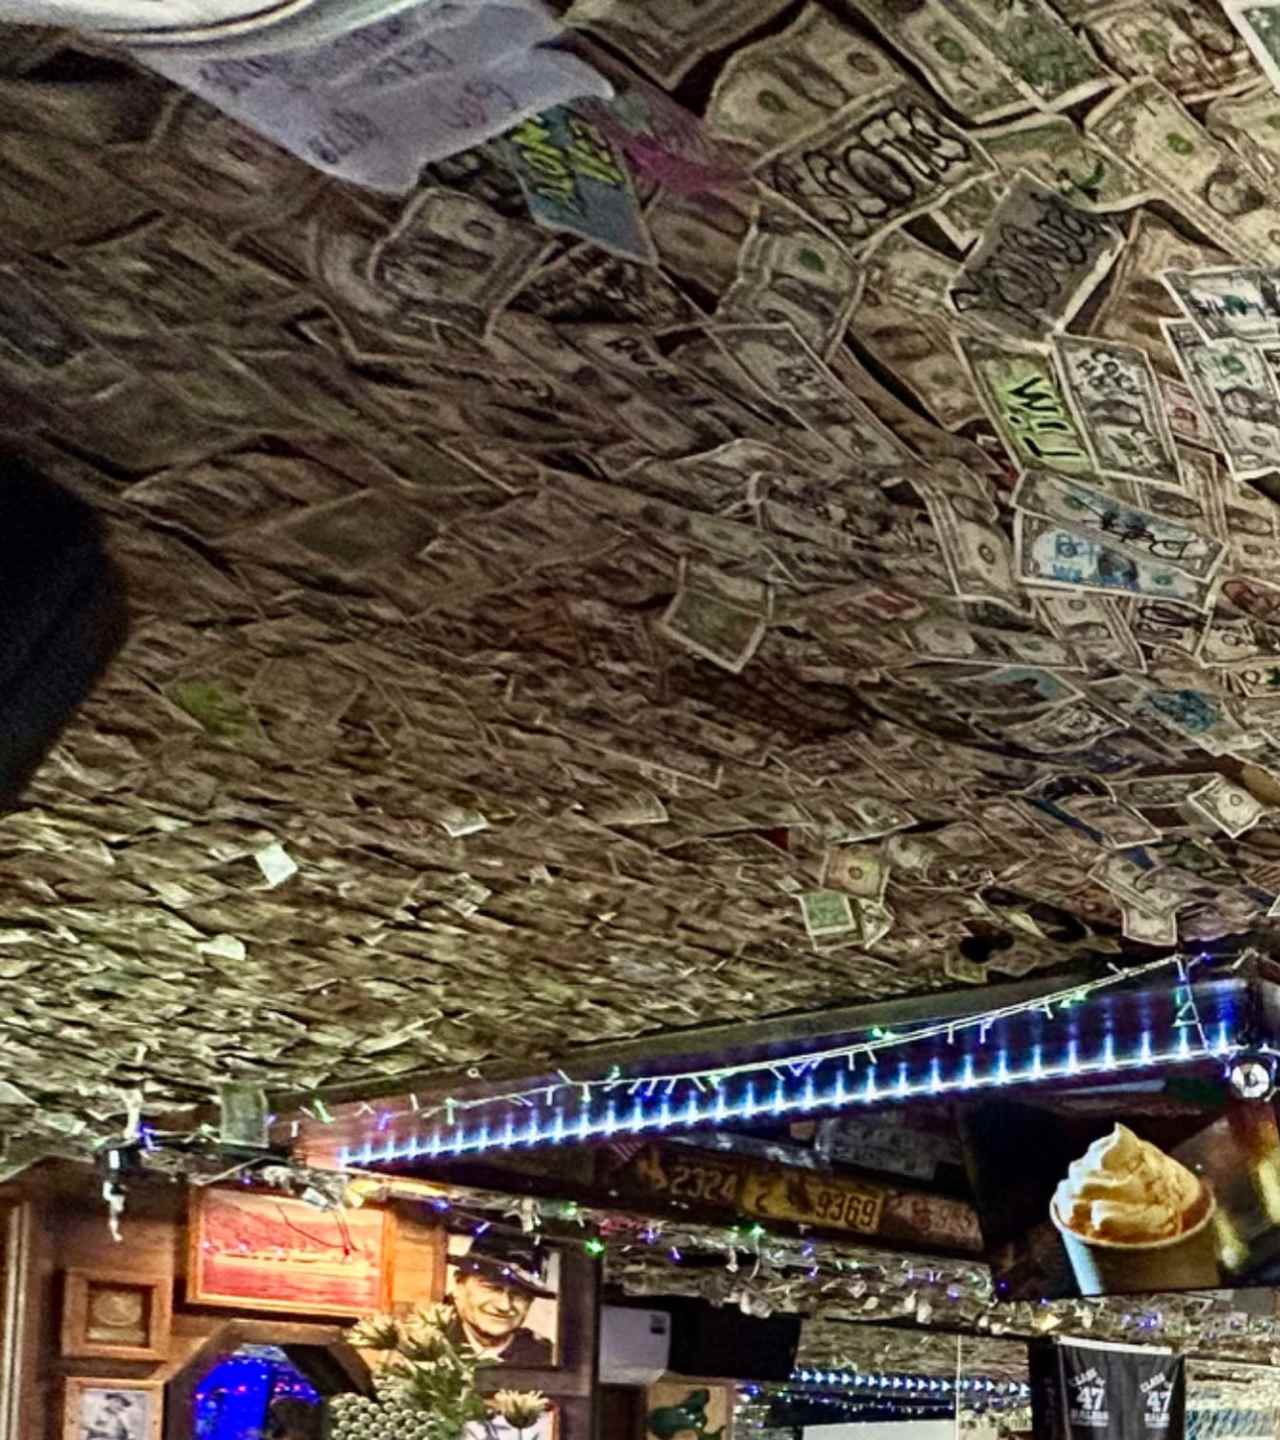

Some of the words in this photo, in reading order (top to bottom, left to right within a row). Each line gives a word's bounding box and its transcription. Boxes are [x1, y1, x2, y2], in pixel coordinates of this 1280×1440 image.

[816, 1190, 878, 1227] 9369
[1077, 1386, 1105, 1410] 47
[1147, 1390, 1172, 1413] 47
